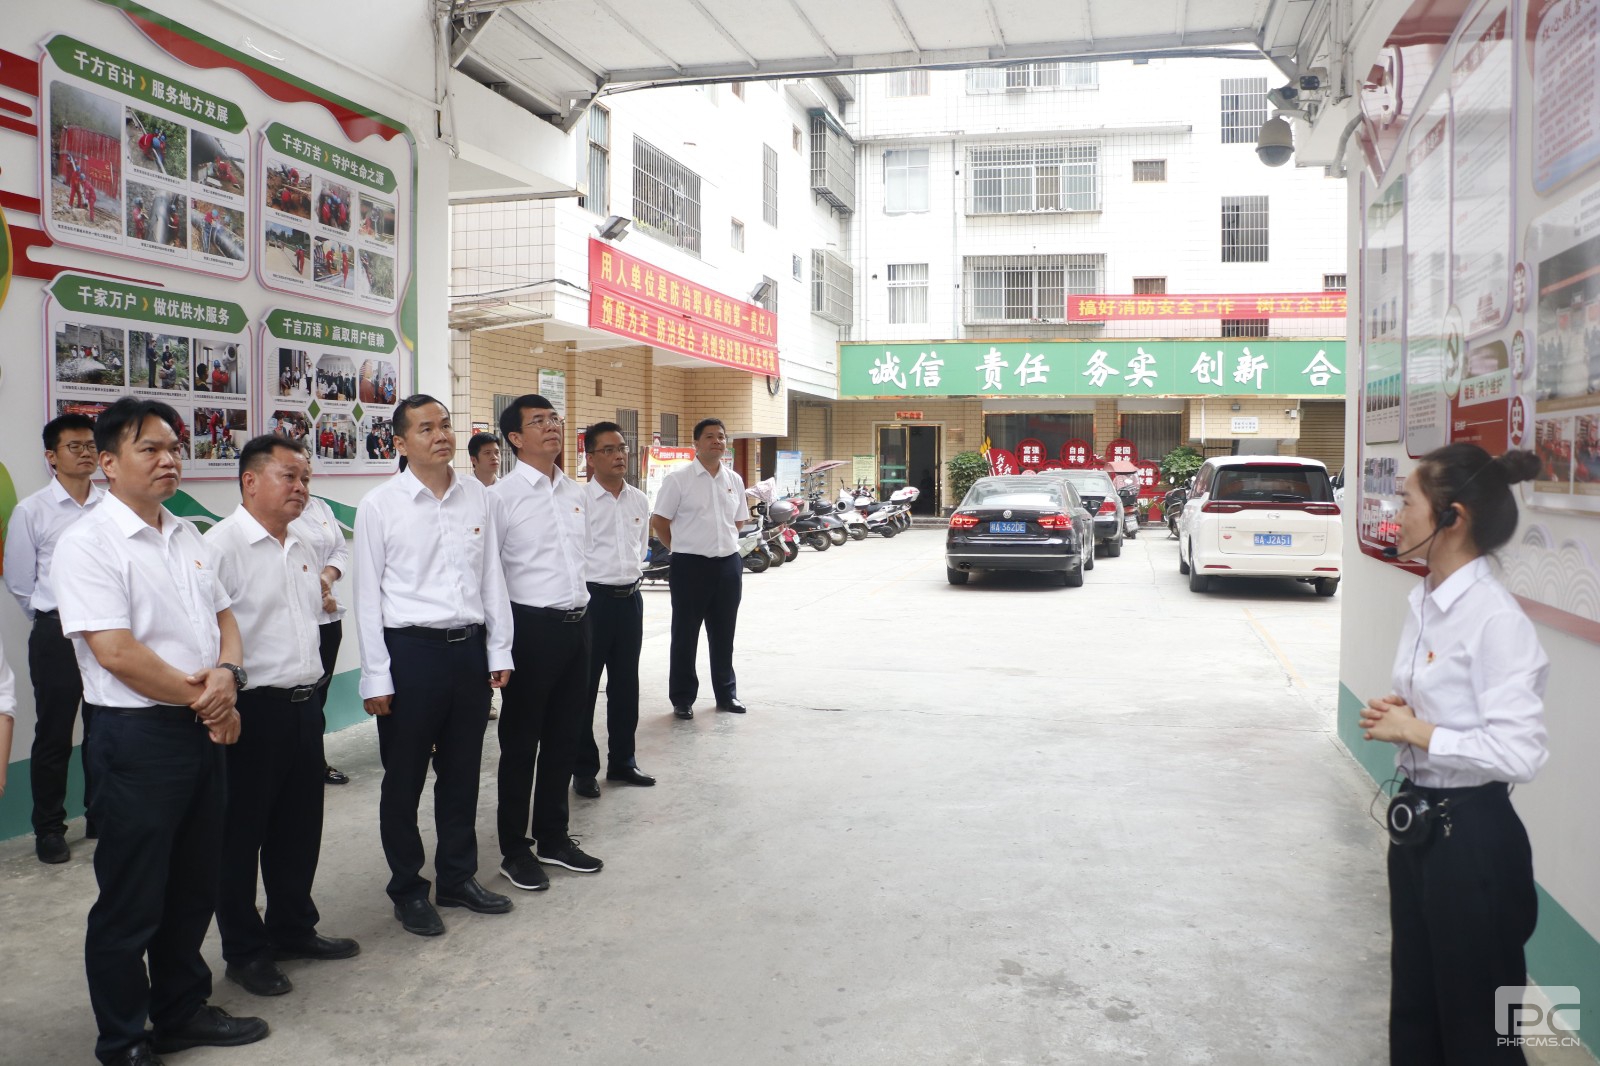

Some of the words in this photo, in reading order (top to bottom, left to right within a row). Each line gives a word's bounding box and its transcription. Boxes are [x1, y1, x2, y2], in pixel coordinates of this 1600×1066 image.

[73, 49, 136, 90] 千方百计
[151, 79, 229, 125] 服务地方发展
[281, 133, 322, 163] 千辛万苦
[331, 153, 385, 186] 守护生命之源
[77, 285, 137, 310] 千家万户
[153, 296, 230, 326] 做优供水服务
[600, 250, 773, 338] 用人单位是防治职业病的第一责任人
[1078, 298, 1235, 316] 搞好消防安全工作
[282, 318, 322, 338] 千言万语
[331, 325, 385, 348] 赢取用户信赖
[601, 295, 649, 338] 预防为主
[656, 316, 696, 352] 防治结合
[868, 351, 945, 390] 诚信
[975, 347, 1051, 391] 责任
[1081, 346, 1158, 389] 务实
[1189, 346, 1269, 390] 创新
[1023, 446, 1040, 454] 富强
[1023, 455, 1040, 463] 民主
[1068, 455, 1085, 464] 平等
[1069, 446, 1085, 455] 自由
[1114, 446, 1131, 455] 爱国
